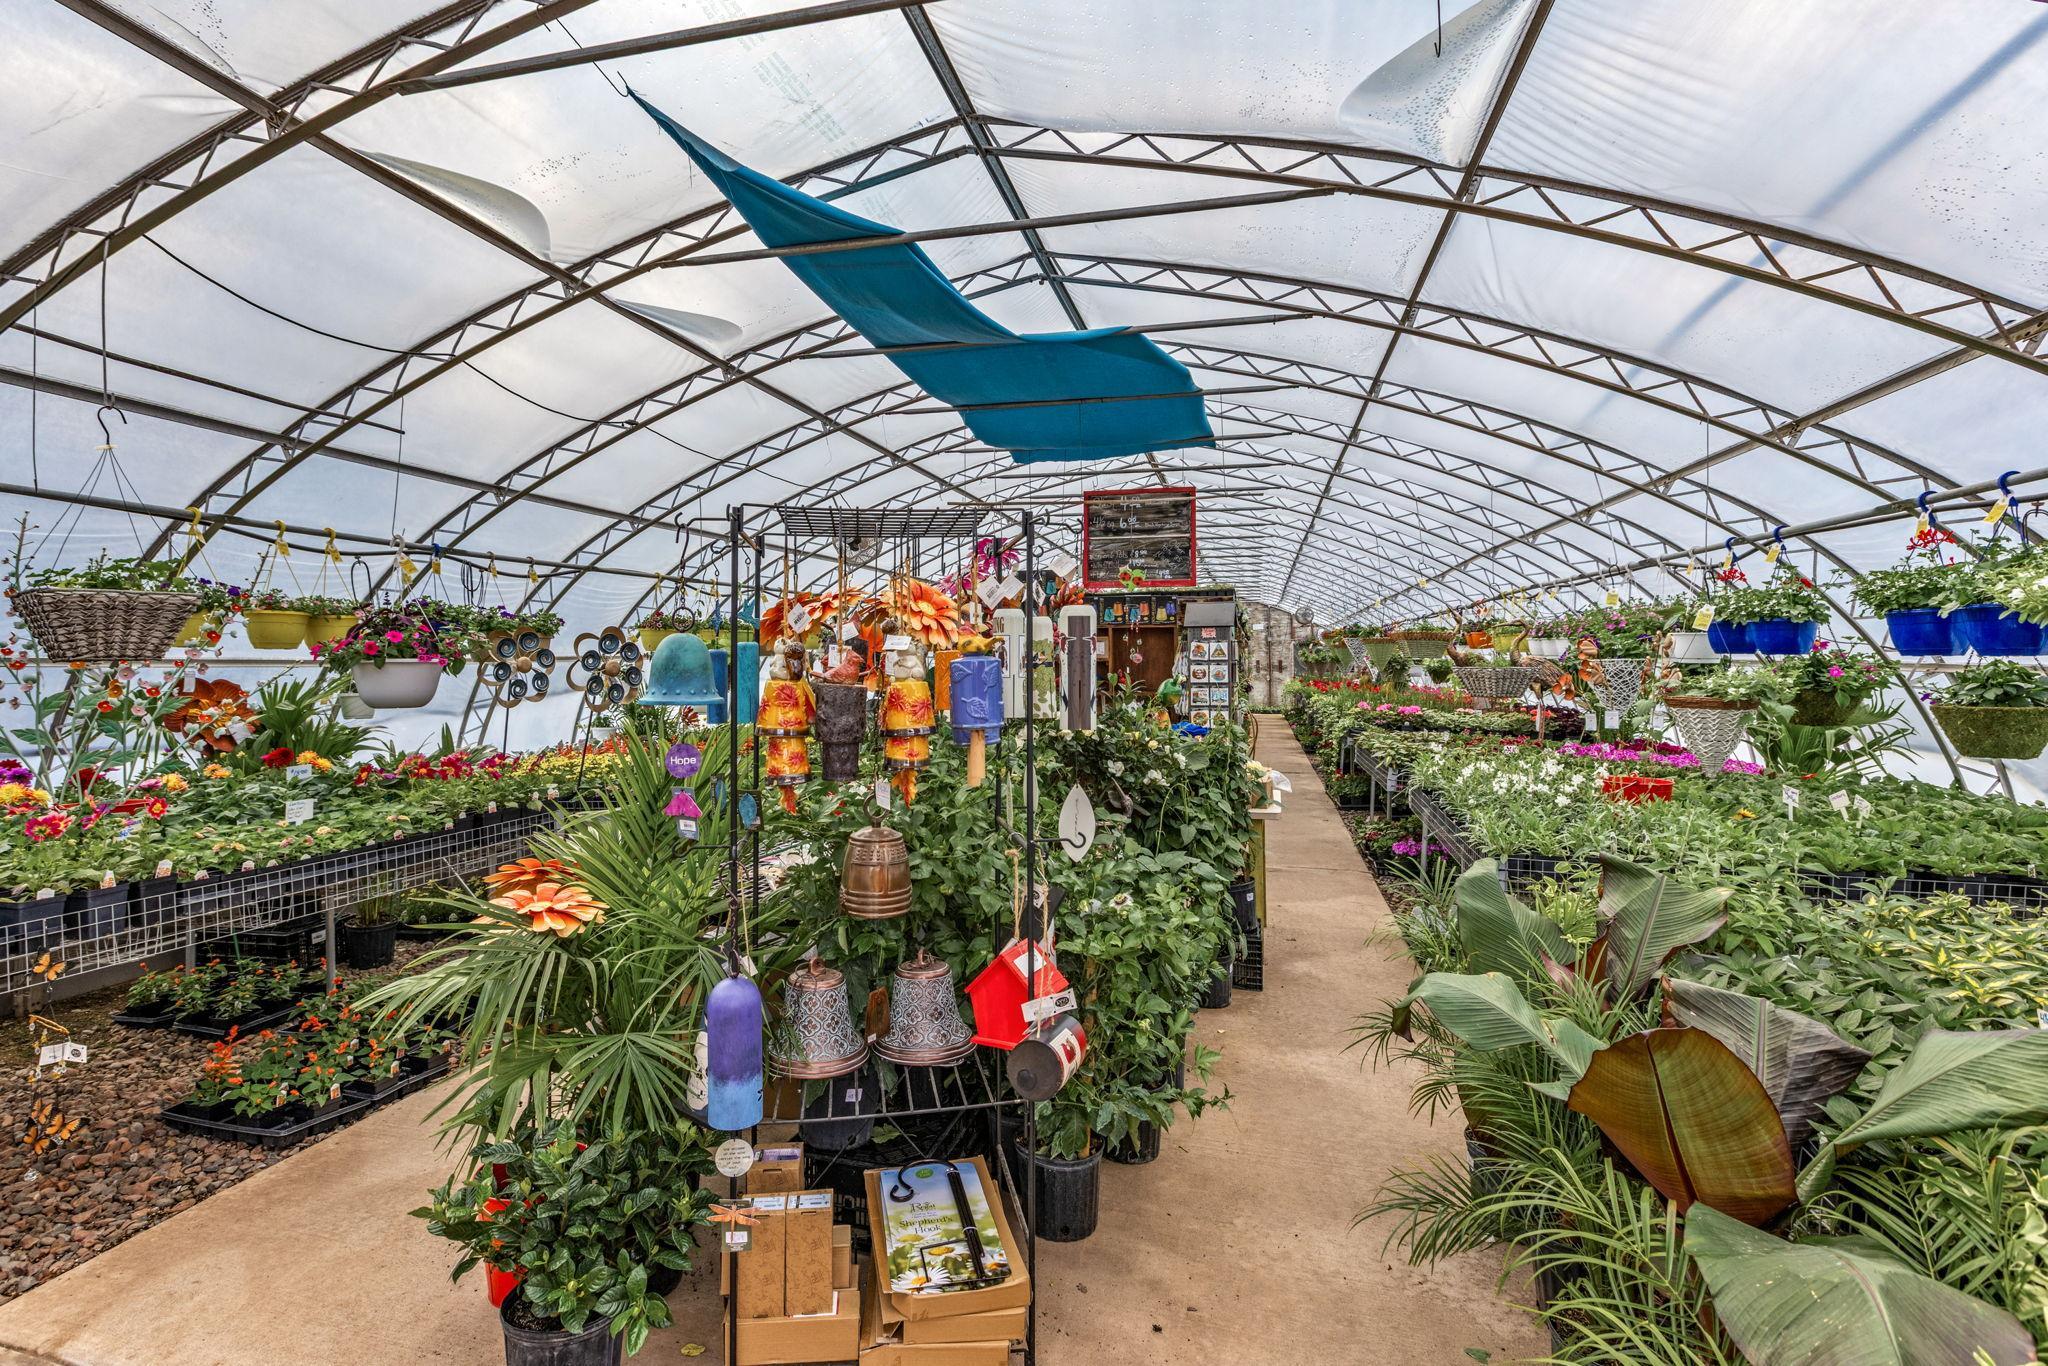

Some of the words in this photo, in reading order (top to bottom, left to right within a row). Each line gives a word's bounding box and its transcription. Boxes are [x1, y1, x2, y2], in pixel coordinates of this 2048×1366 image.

[670, 756, 696, 765] Hope
[899, 1215, 953, 1228] Shepherd's
[914, 1224, 942, 1235] Hook
